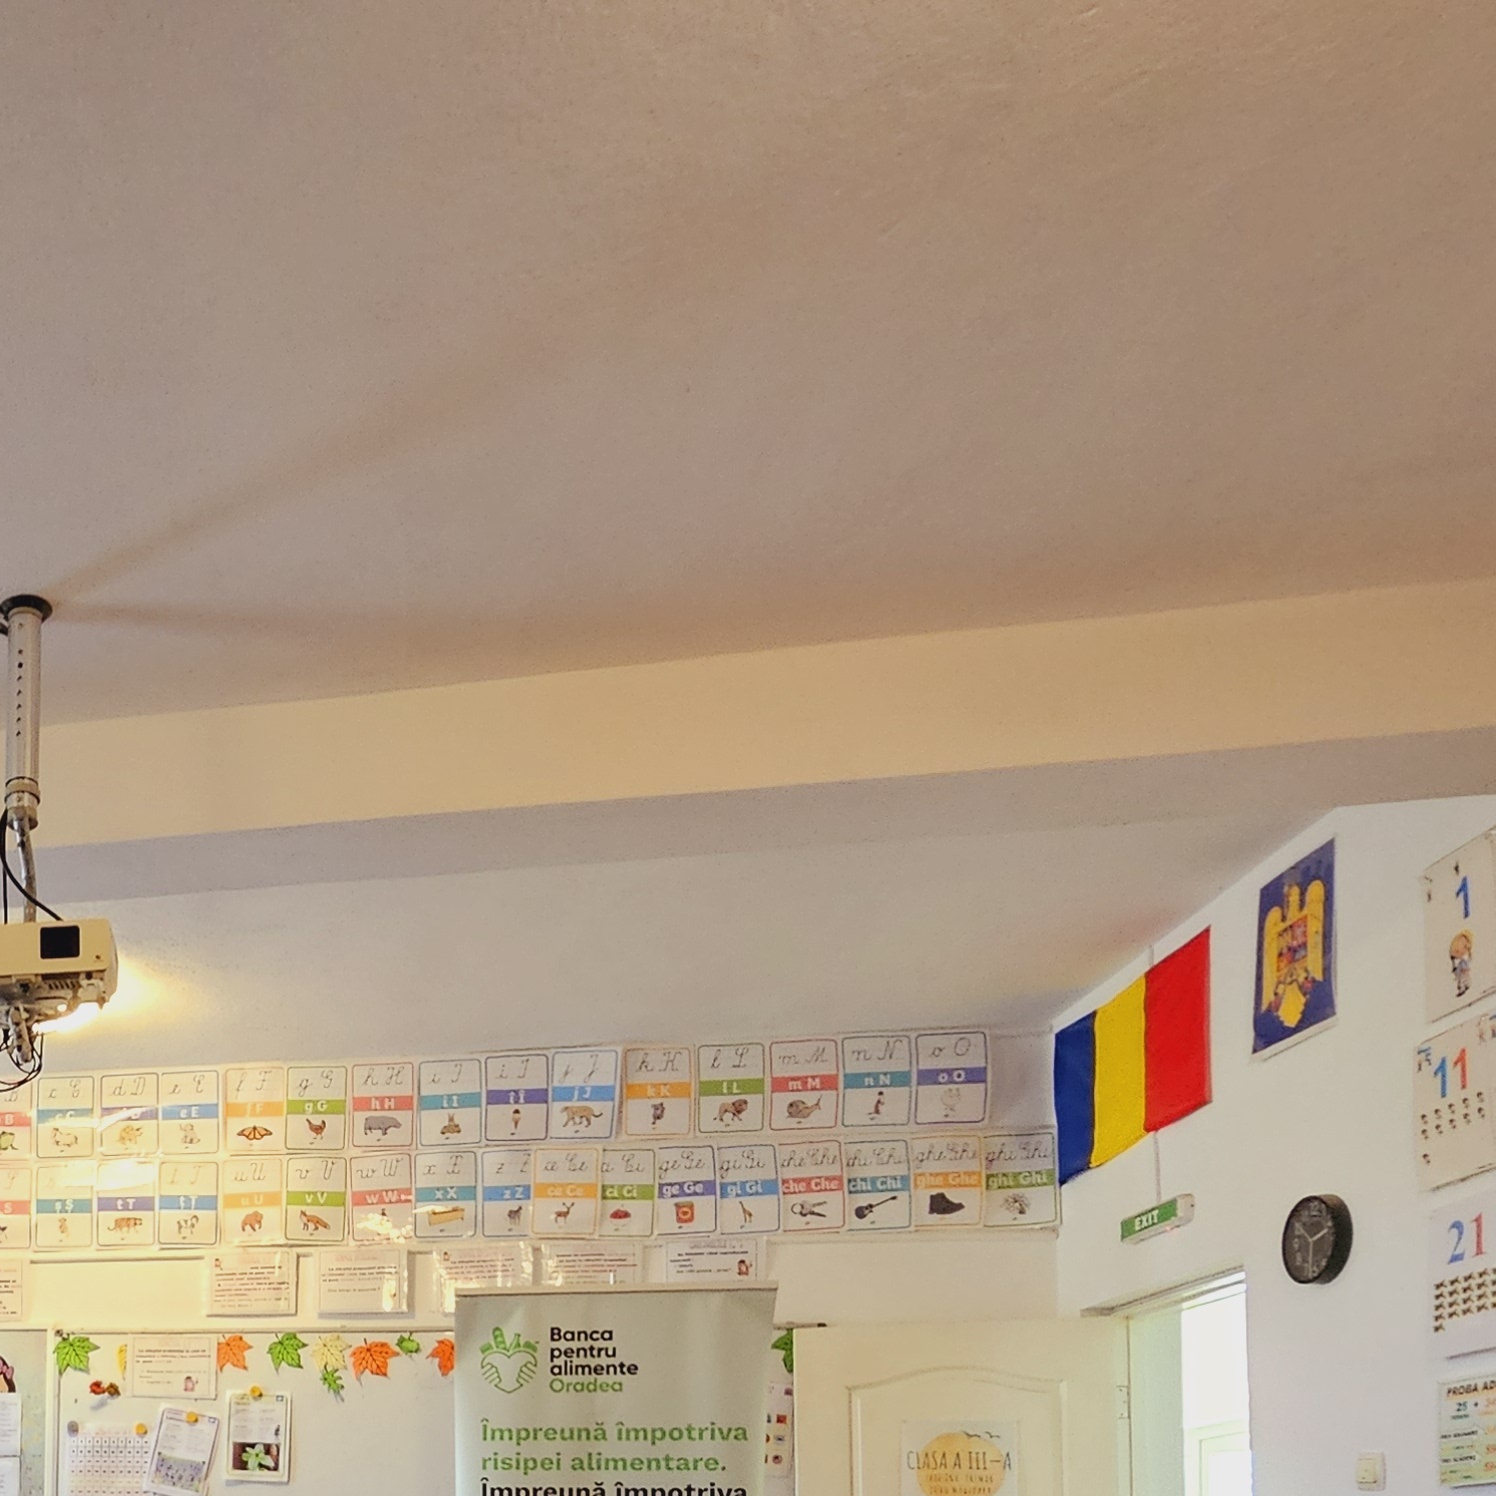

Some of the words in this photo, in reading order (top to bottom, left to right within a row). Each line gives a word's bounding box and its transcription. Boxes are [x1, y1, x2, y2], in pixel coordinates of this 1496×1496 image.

[1455, 876, 1470, 919] 1
[1433, 1047, 1467, 1099] 11
[684, 1181, 704, 1193] Ge
[746, 1180, 763, 1193] Gi
[783, 1179, 806, 1193] che
[811, 1177, 839, 1190] Che
[849, 1177, 871, 1191] chi
[876, 1175, 902, 1189] Chi
[1135, 1209, 1159, 1231] EXIT
[1447, 1212, 1487, 1265] 21
[550, 1326, 613, 1342] Banca
[550, 1344, 616, 1362] pentru
[550, 1360, 639, 1376] alimente
[549, 1378, 623, 1393] Oradea
[1447, 1383, 1478, 1397] PROBA
[480, 1418, 607, 1446] Împreună
[615, 1421, 749, 1446] împotriva
[481, 1452, 562, 1475] risipei
[570, 1452, 726, 1472] alimentare.
[907, 1451, 947, 1470] CLASA
[954, 1451, 962, 1469] A
